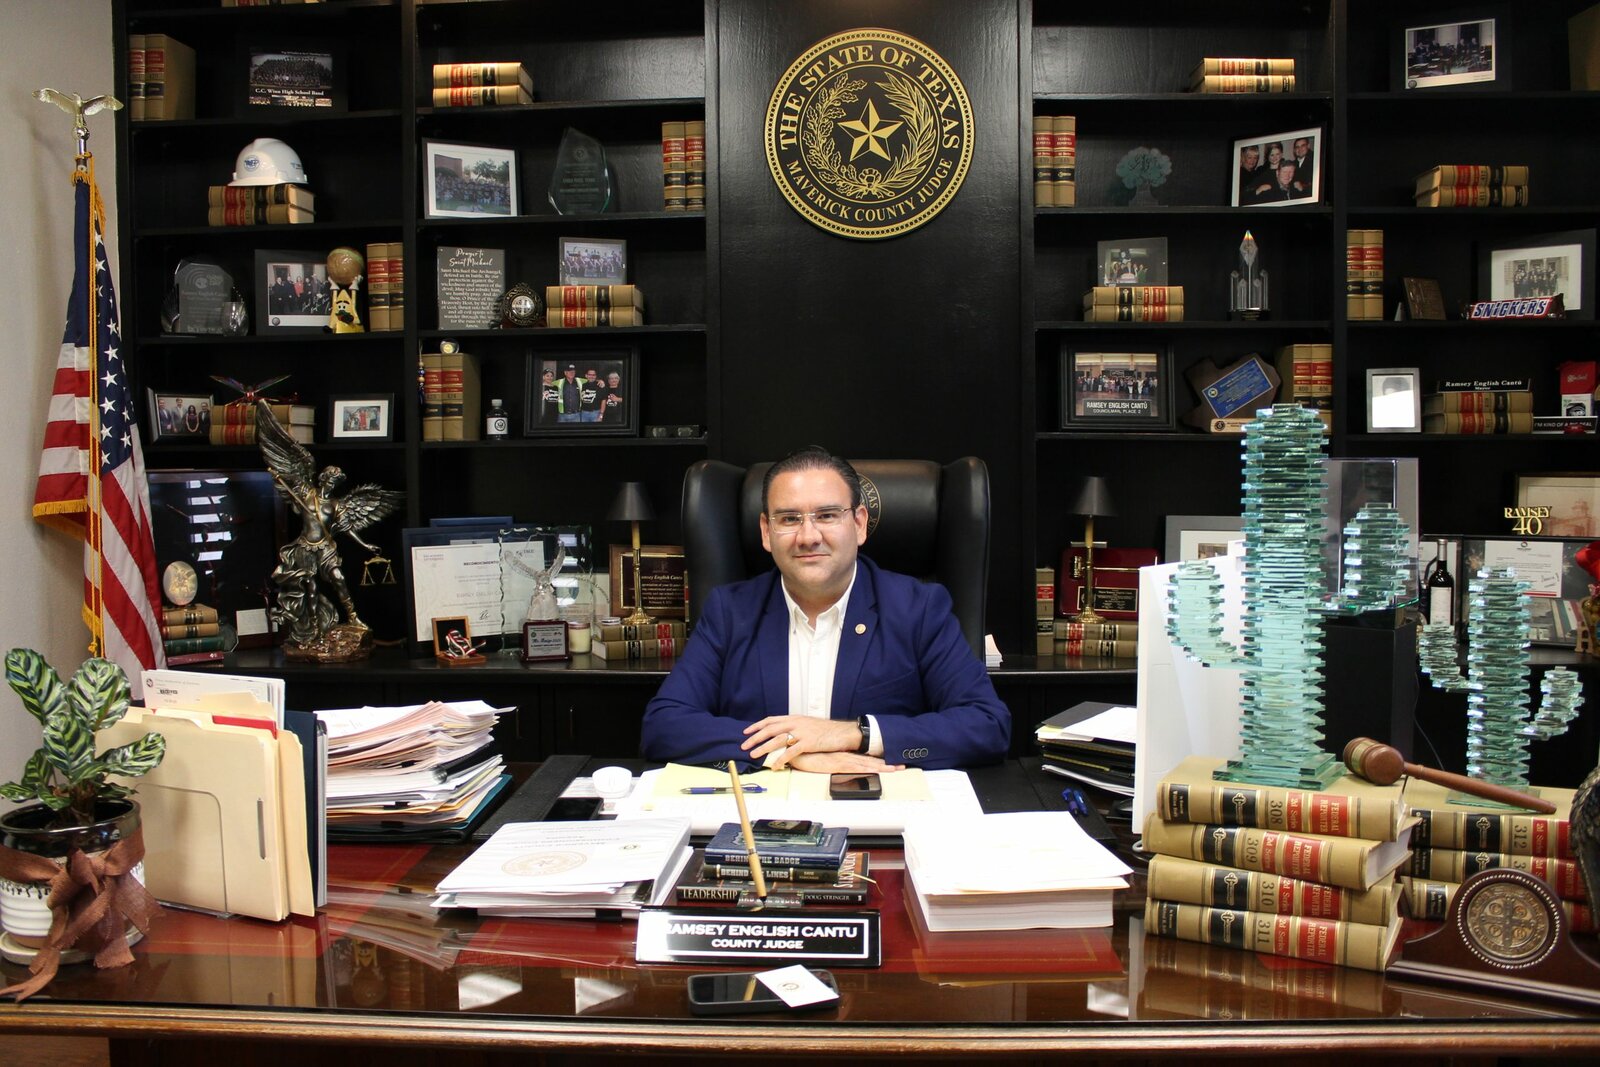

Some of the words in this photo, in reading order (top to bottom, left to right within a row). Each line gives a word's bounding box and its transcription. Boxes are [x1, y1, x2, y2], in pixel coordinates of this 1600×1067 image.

[780, 93, 806, 150] THE
[800, 45, 873, 91] STATE
[880, 47, 916, 68] OF
[916, 63, 960, 150] TEXAS
[787, 160, 851, 219] MAVERICK
[855, 197, 916, 222] COUNTY
[919, 159, 953, 203] JUDGE
[449, 258, 466, 266] Saint
[467, 258, 493, 267] Michael
[456, 248, 476, 258] Prayer
[1474, 299, 1548, 318] SNICKERS
[859, 480, 878, 509] TEXAS
[1504, 506, 1550, 518] RAMSEY
[1512, 516, 1542, 535] 40
[1270, 800, 1283, 824] 308
[1291, 798, 1298, 807] 2d
[1320, 800, 1328, 832] REPORTER
[1331, 802, 1339, 831] FEDERAL
[1513, 824, 1528, 849] 312
[1536, 823, 1544, 832] 2d
[1246, 838, 1258, 863] 309
[1266, 836, 1273, 846] 2d
[1292, 841, 1302, 875] REPORTER
[1303, 844, 1312, 874] FEDERAL
[683, 889, 738, 900] LEADERSHIP
[1261, 881, 1275, 906] 310
[1283, 880, 1290, 889] 2d
[1312, 884, 1320, 916] REPORTER
[1323, 886, 1332, 915] FEDERAL
[666, 923, 727, 936] RAMSEY
[729, 925, 799, 937] ENGLISH
[801, 926, 858, 938] CANTU
[1258, 920, 1271, 944] 311
[1280, 919, 1288, 928] 2d
[1307, 922, 1316, 956] REPORTER
[1318, 926, 1327, 956] FEDERAL
[711, 939, 762, 948] COUNTY
[762, 940, 803, 949] JUDGE
